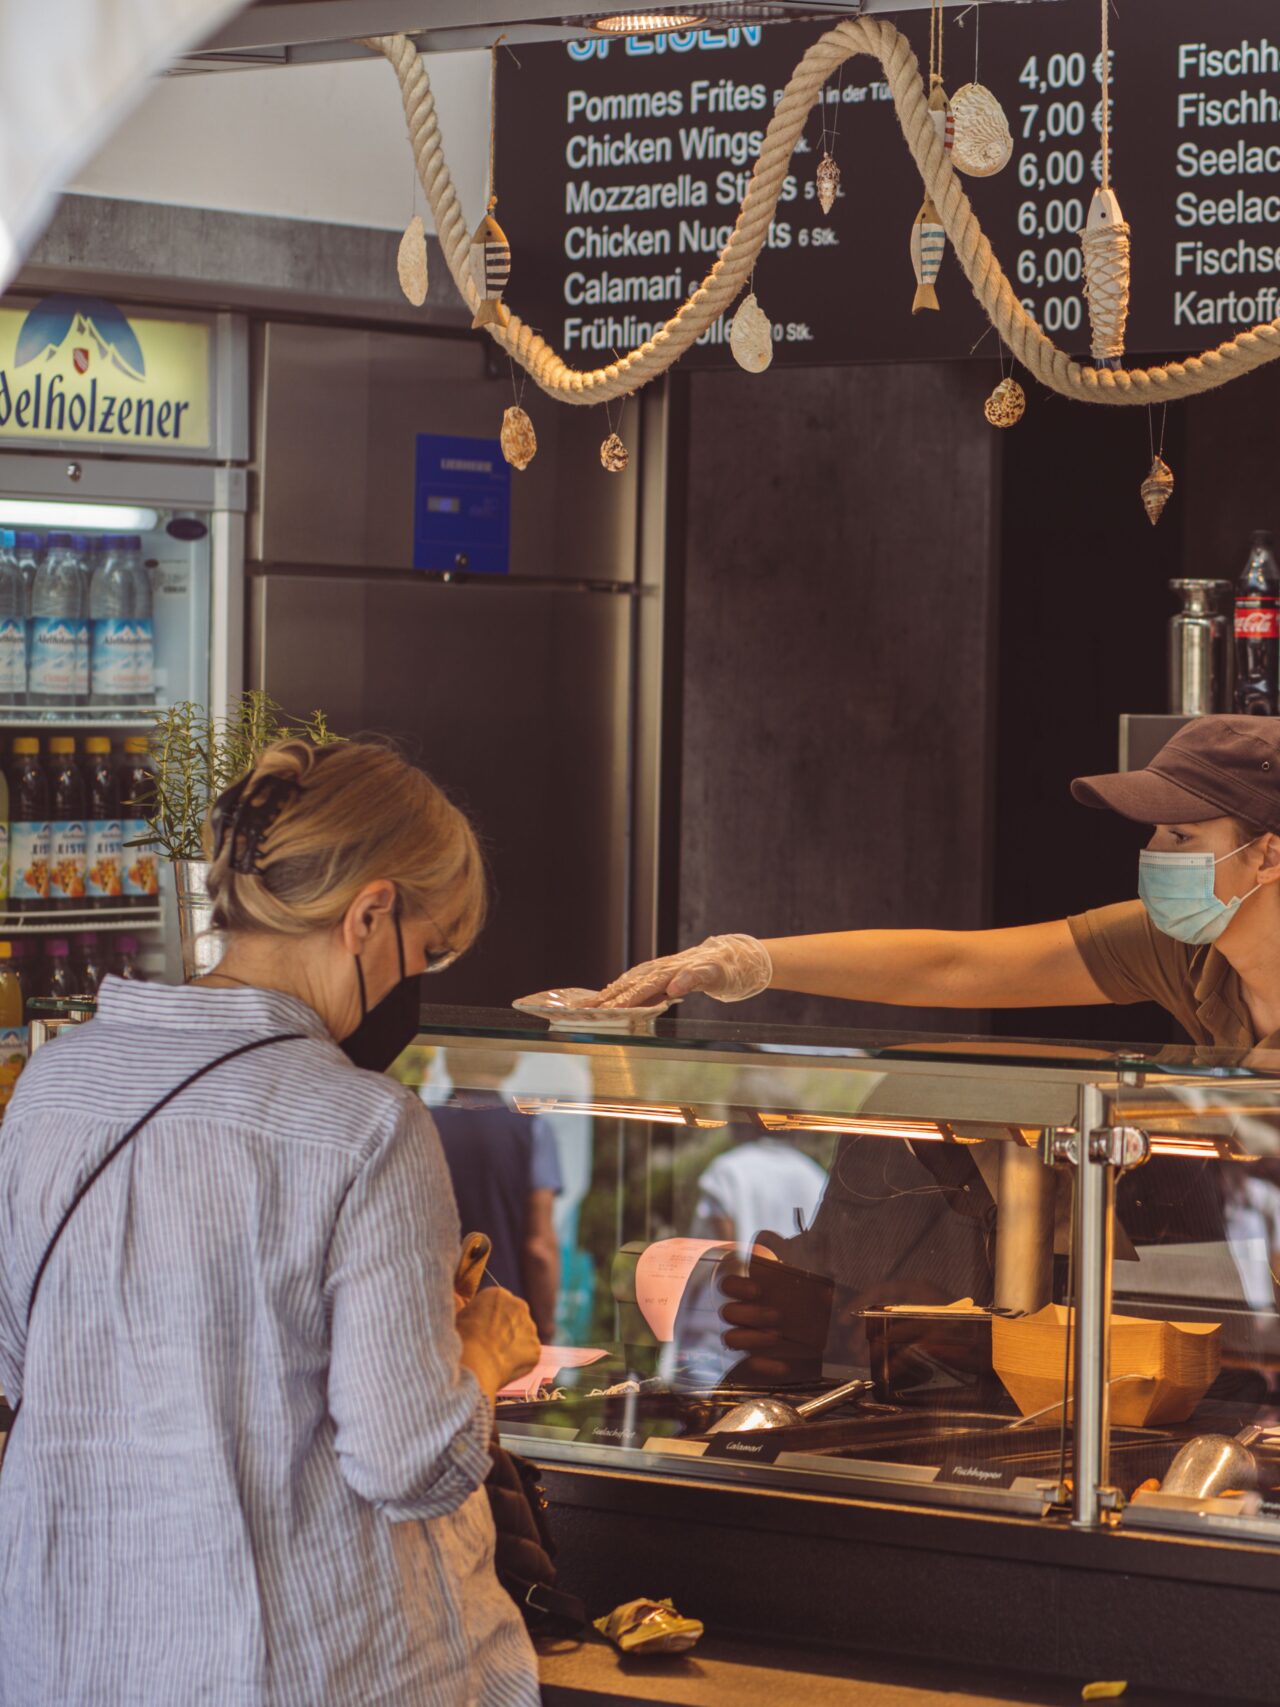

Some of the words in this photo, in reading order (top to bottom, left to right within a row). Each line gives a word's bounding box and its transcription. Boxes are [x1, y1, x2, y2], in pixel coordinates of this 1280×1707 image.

[1018, 52, 1085, 94] 4,00
[1092, 50, 1115, 84] €
[567, 88, 683, 123] Pommes
[690, 79, 767, 113] Frites
[842, 84, 868, 103] der
[1018, 101, 1085, 143] 7,00
[1091, 99, 1114, 133] €
[565, 135, 672, 169] Chicken
[679, 126, 764, 166] Wings
[1018, 150, 1084, 191] 6,00
[1090, 148, 1113, 181] €
[565, 174, 708, 215] Mozzarella
[804, 181, 815, 199] 5
[1017, 198, 1083, 240] 6,00
[564, 225, 671, 260] Chicken
[798, 228, 809, 247] 6
[564, 267, 682, 306] Calamari
[1017, 247, 1082, 288] 6,00
